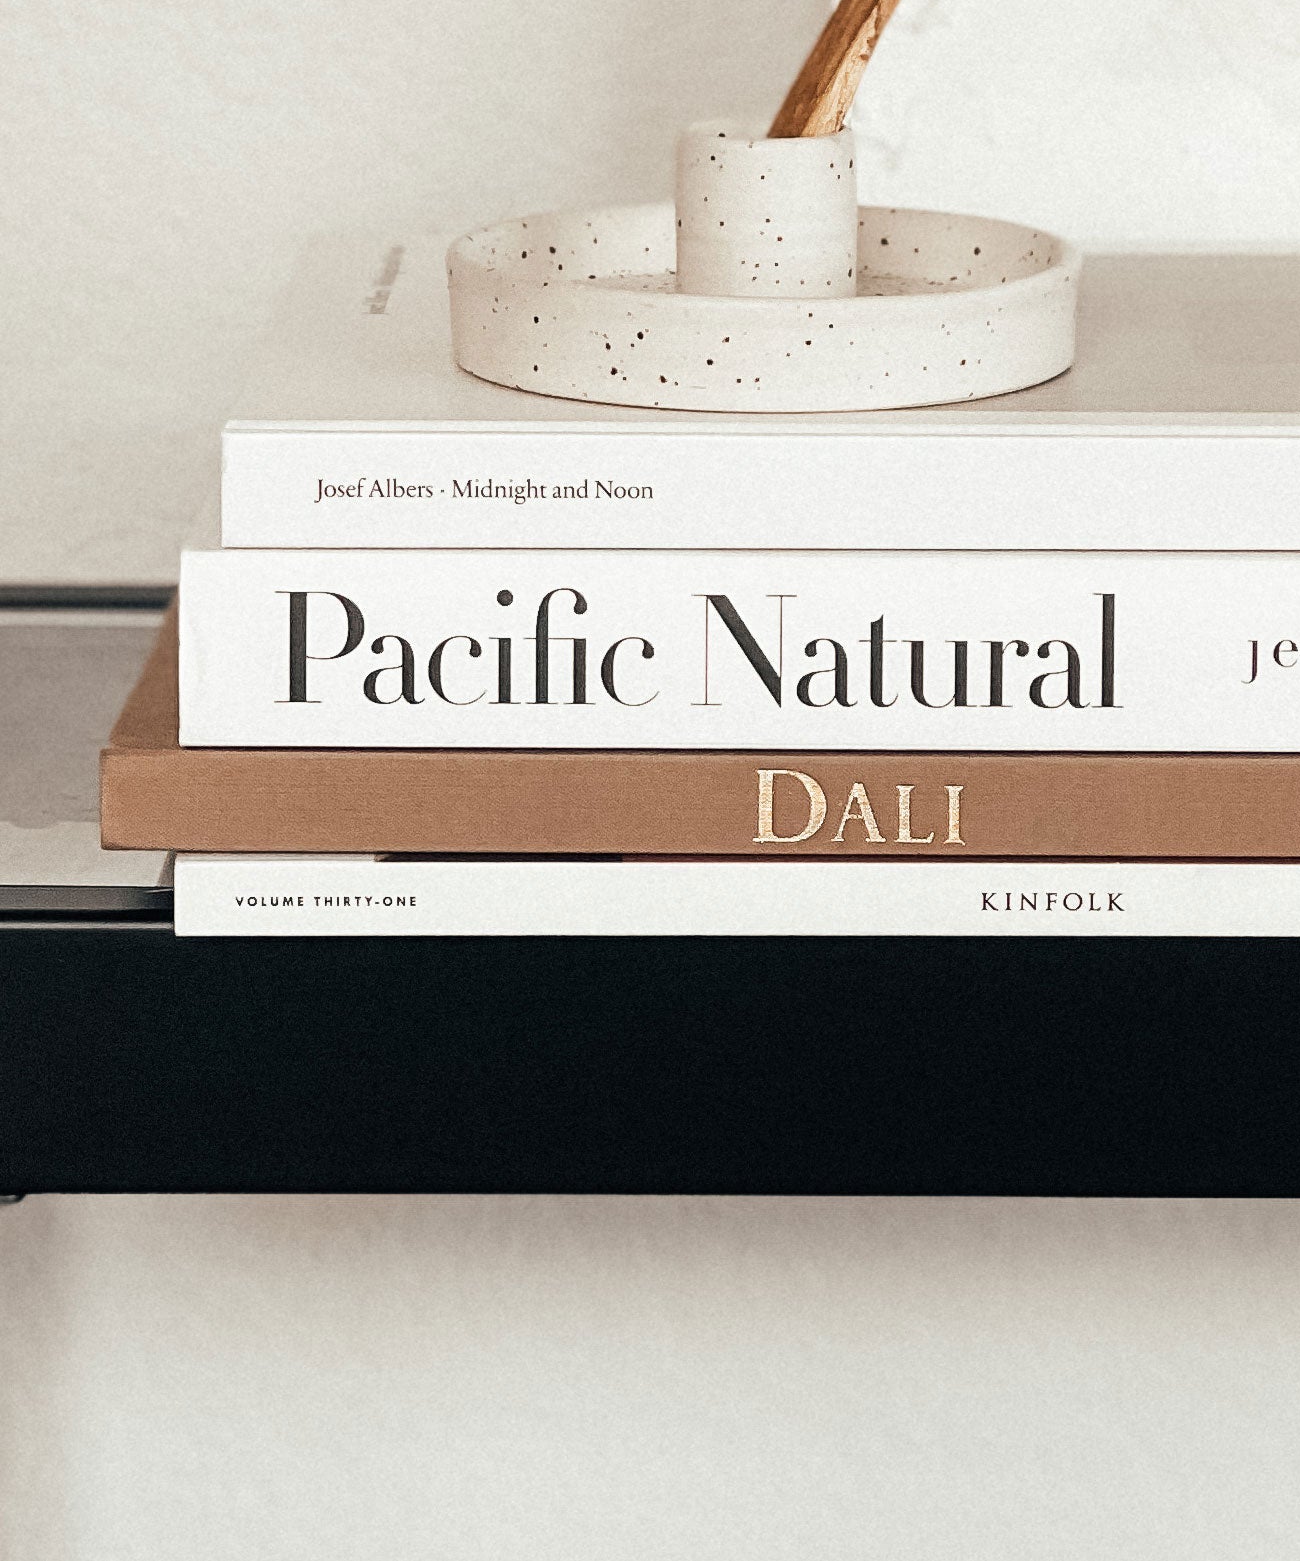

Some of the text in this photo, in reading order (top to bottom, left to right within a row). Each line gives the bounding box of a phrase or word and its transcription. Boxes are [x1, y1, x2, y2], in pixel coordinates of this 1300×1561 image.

[314, 477, 366, 504] Josef
[368, 478, 434, 500] Albers
[452, 478, 548, 506] Midnight
[552, 478, 590, 500] and
[594, 480, 654, 501] Noon
[274, 587, 1125, 710] Pacific Natural
[752, 767, 967, 847] DALI
[234, 894, 418, 908] VOLUME THIRTY-ONE
[980, 892, 1126, 913] KINFOLK
